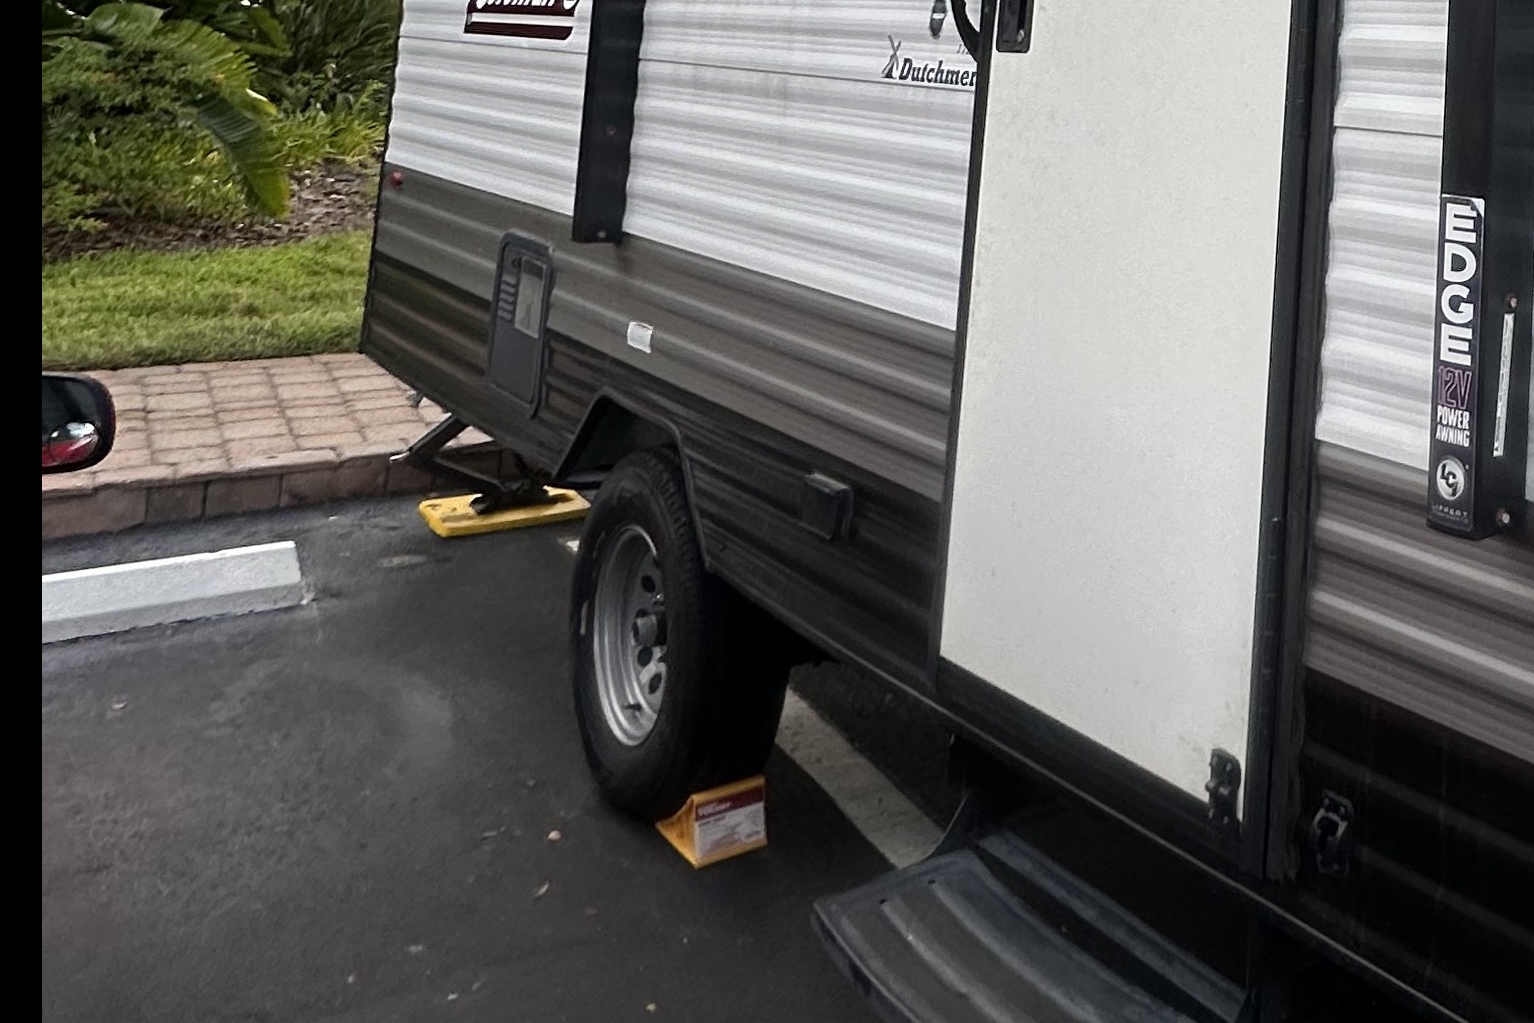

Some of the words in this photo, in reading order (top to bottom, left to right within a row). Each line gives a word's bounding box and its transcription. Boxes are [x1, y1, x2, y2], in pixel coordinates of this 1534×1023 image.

[1440, 202, 1477, 366] EDGE
[1438, 366, 1472, 410] 12V
[1437, 405, 1470, 429] POWER
[1435, 424, 1471, 447] AWNING
